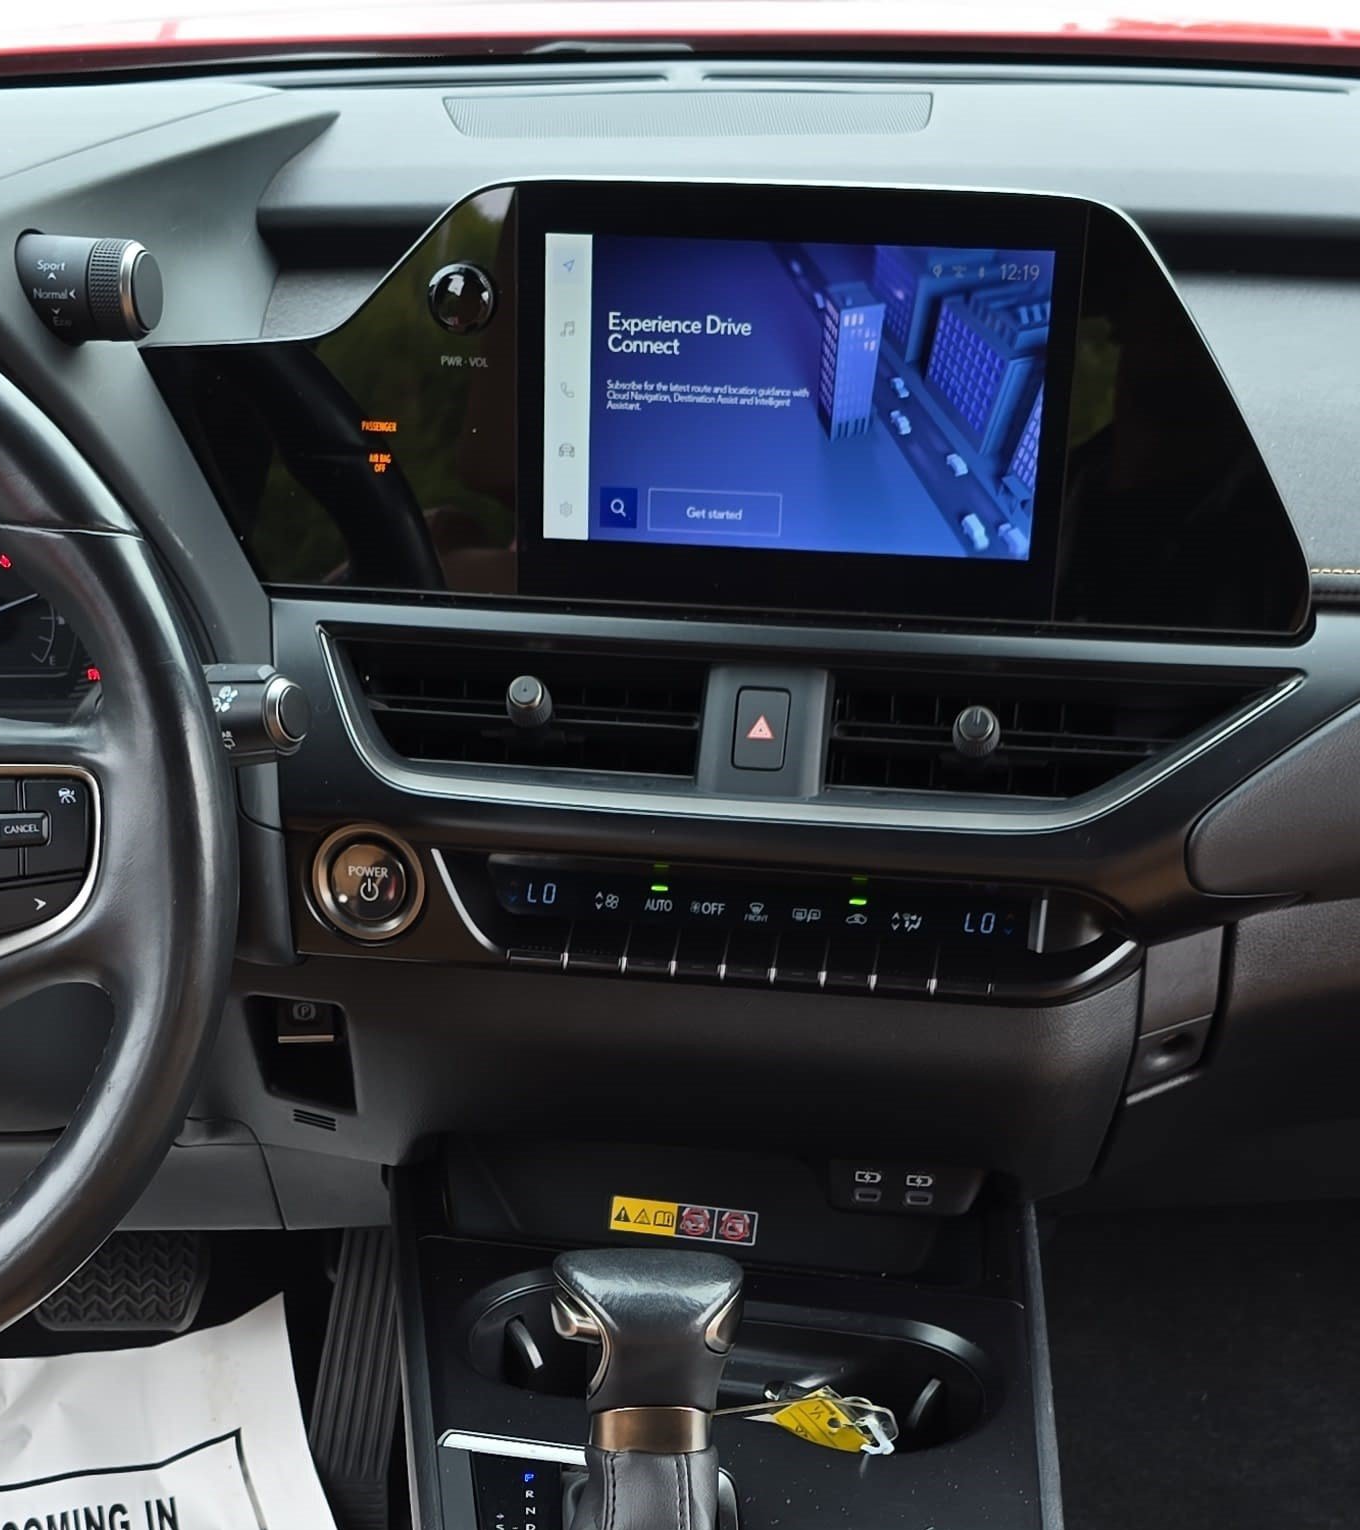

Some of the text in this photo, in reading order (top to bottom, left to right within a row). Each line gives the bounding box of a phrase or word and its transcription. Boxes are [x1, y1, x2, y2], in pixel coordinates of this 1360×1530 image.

[36, 260, 66, 272] Sport
[1000, 263, 1040, 281] 12:19
[33, 288, 69, 300] Normal
[608, 311, 753, 336] Experience Drive
[607, 334, 681, 356] Connect
[440, 355, 489, 368] PWR VOL
[606, 379, 642, 391] Subscribe
[643, 381, 655, 391] for
[656, 382, 668, 392] the
[669, 382, 690, 393] latest
[728, 385, 757, 396] location
[758, 386, 791, 398] guidance
[792, 388, 810, 399] with
[606, 390, 630, 401] Cloud
[673, 393, 716, 404] Destination
[361, 420, 397, 432] PASSENGER
[686, 506, 744, 521] Get started
[3, 823, 40, 834] CANCEL
[347, 865, 389, 878] POWER
[644, 898, 673, 912] AUTO
[701, 901, 726, 916] OFF
[525, 1489, 535, 1499] R
[525, 1506, 536, 1515] N
